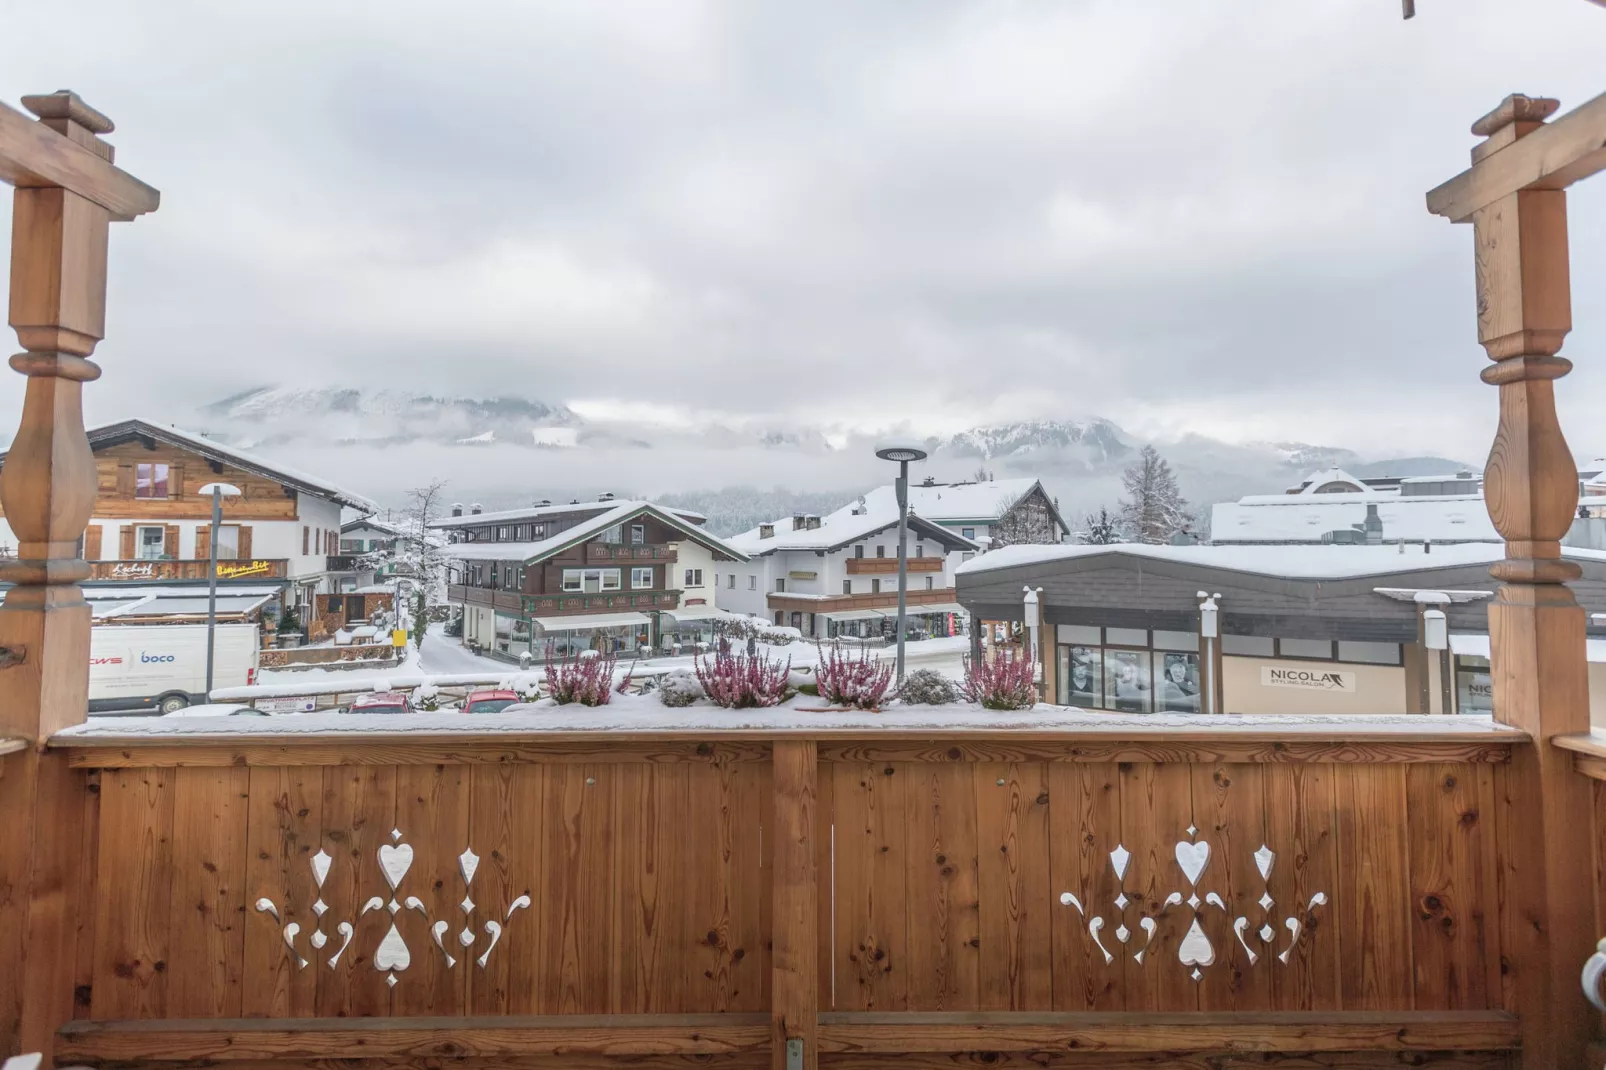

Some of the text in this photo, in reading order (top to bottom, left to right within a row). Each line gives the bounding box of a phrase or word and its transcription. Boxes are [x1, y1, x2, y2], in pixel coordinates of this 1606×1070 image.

[141, 651, 175, 663] boco
[1271, 669, 1332, 682] NICOLA
[1469, 683, 1492, 694] NIC
